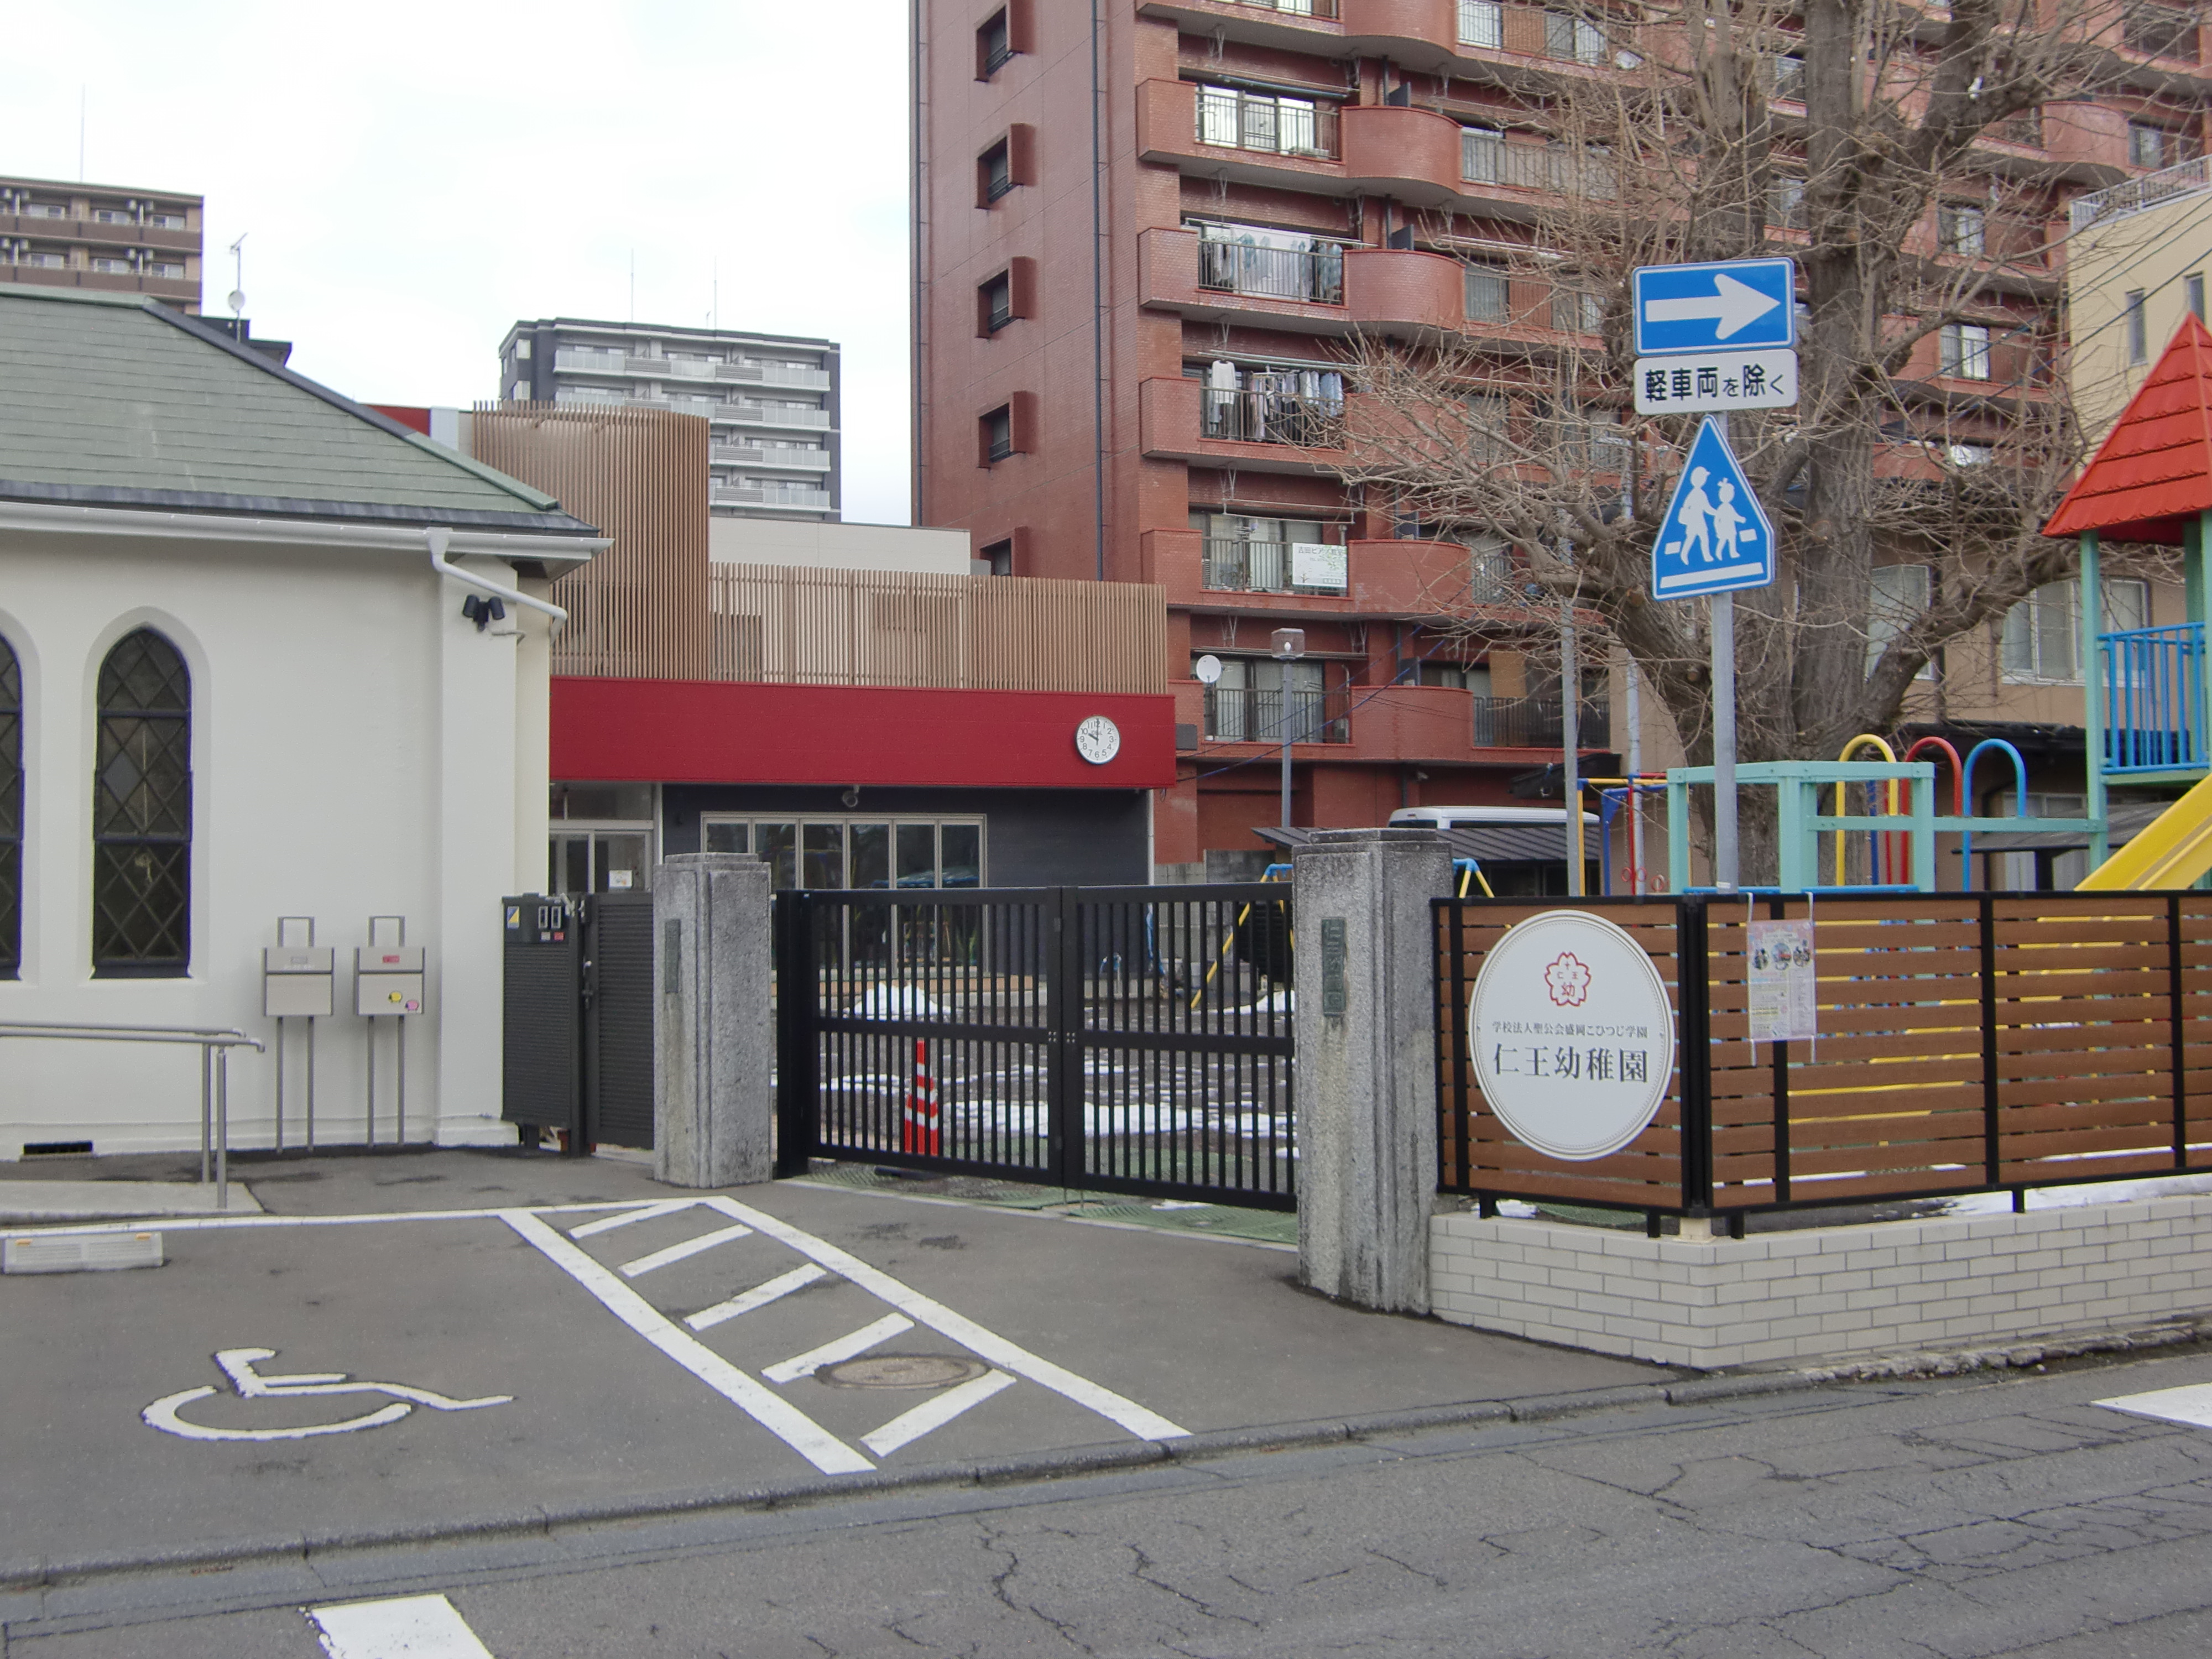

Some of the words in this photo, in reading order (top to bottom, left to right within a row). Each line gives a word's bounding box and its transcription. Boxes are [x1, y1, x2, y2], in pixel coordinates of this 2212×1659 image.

[1645, 363, 1786, 403] 軽車両を除く
[1492, 1021, 1648, 1039] 学校法人聖公会盛岡こひつじ学園
[1493, 1043, 1649, 1083] 仁王幼稚園
